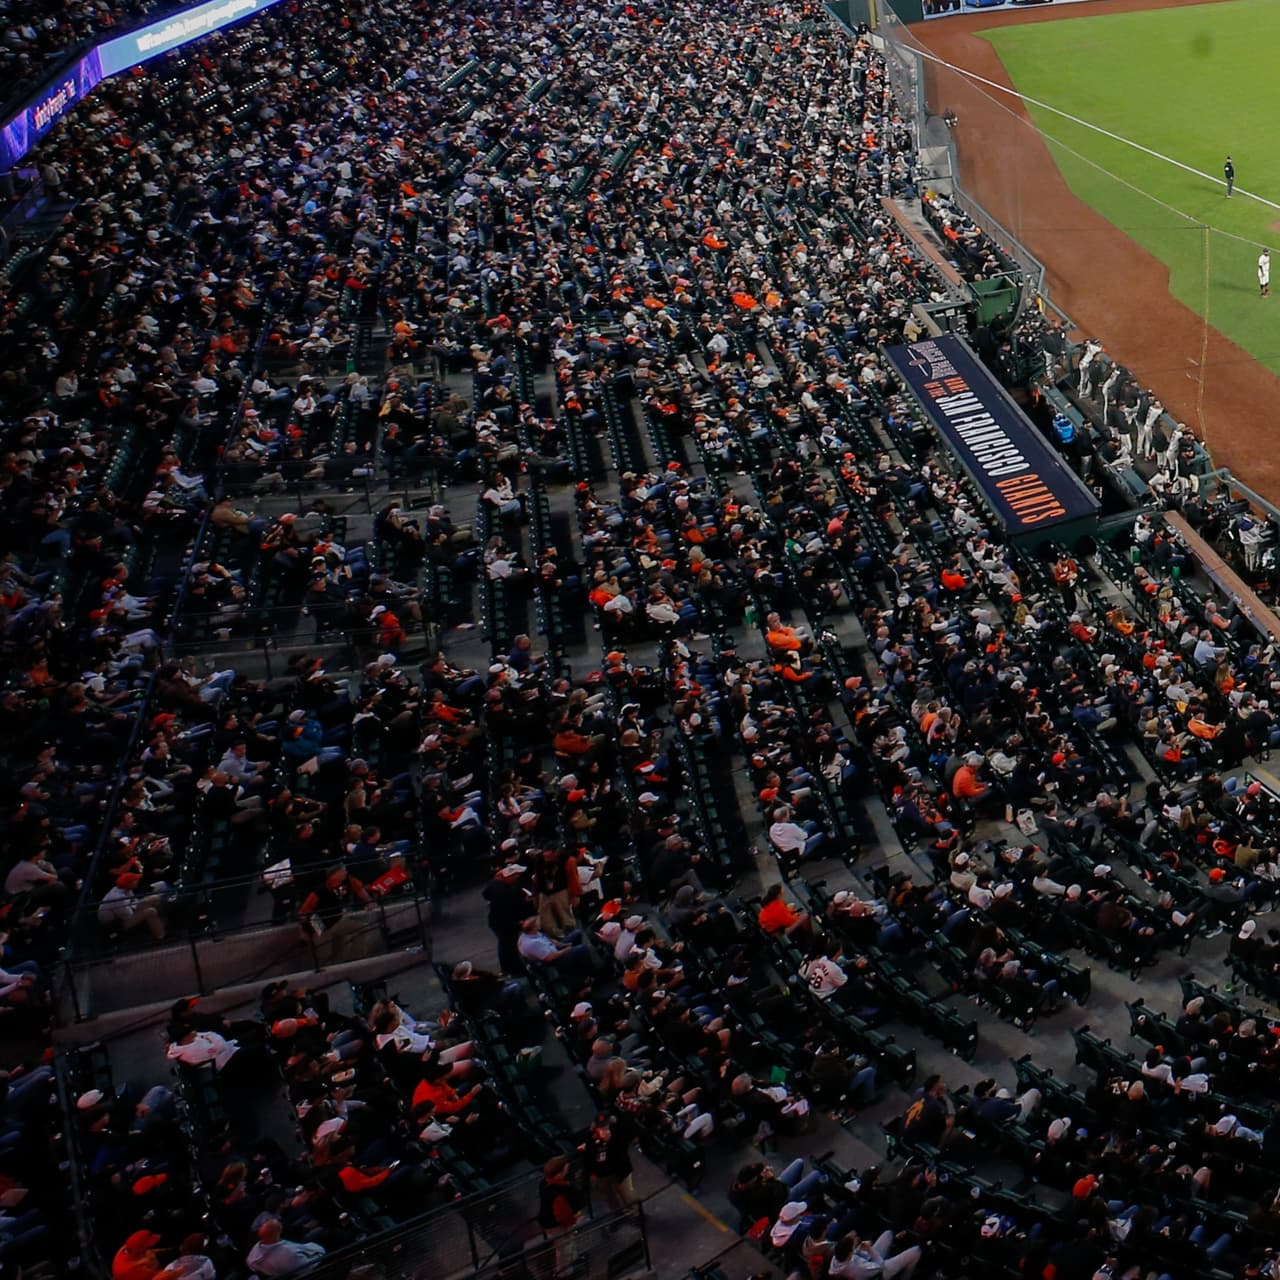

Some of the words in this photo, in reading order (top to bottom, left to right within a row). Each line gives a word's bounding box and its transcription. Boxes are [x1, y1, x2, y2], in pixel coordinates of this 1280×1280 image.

[935, 391, 985, 417] SAN
[950, 411, 1031, 477] FRANCISCO
[995, 473, 1066, 524] GIANTS
